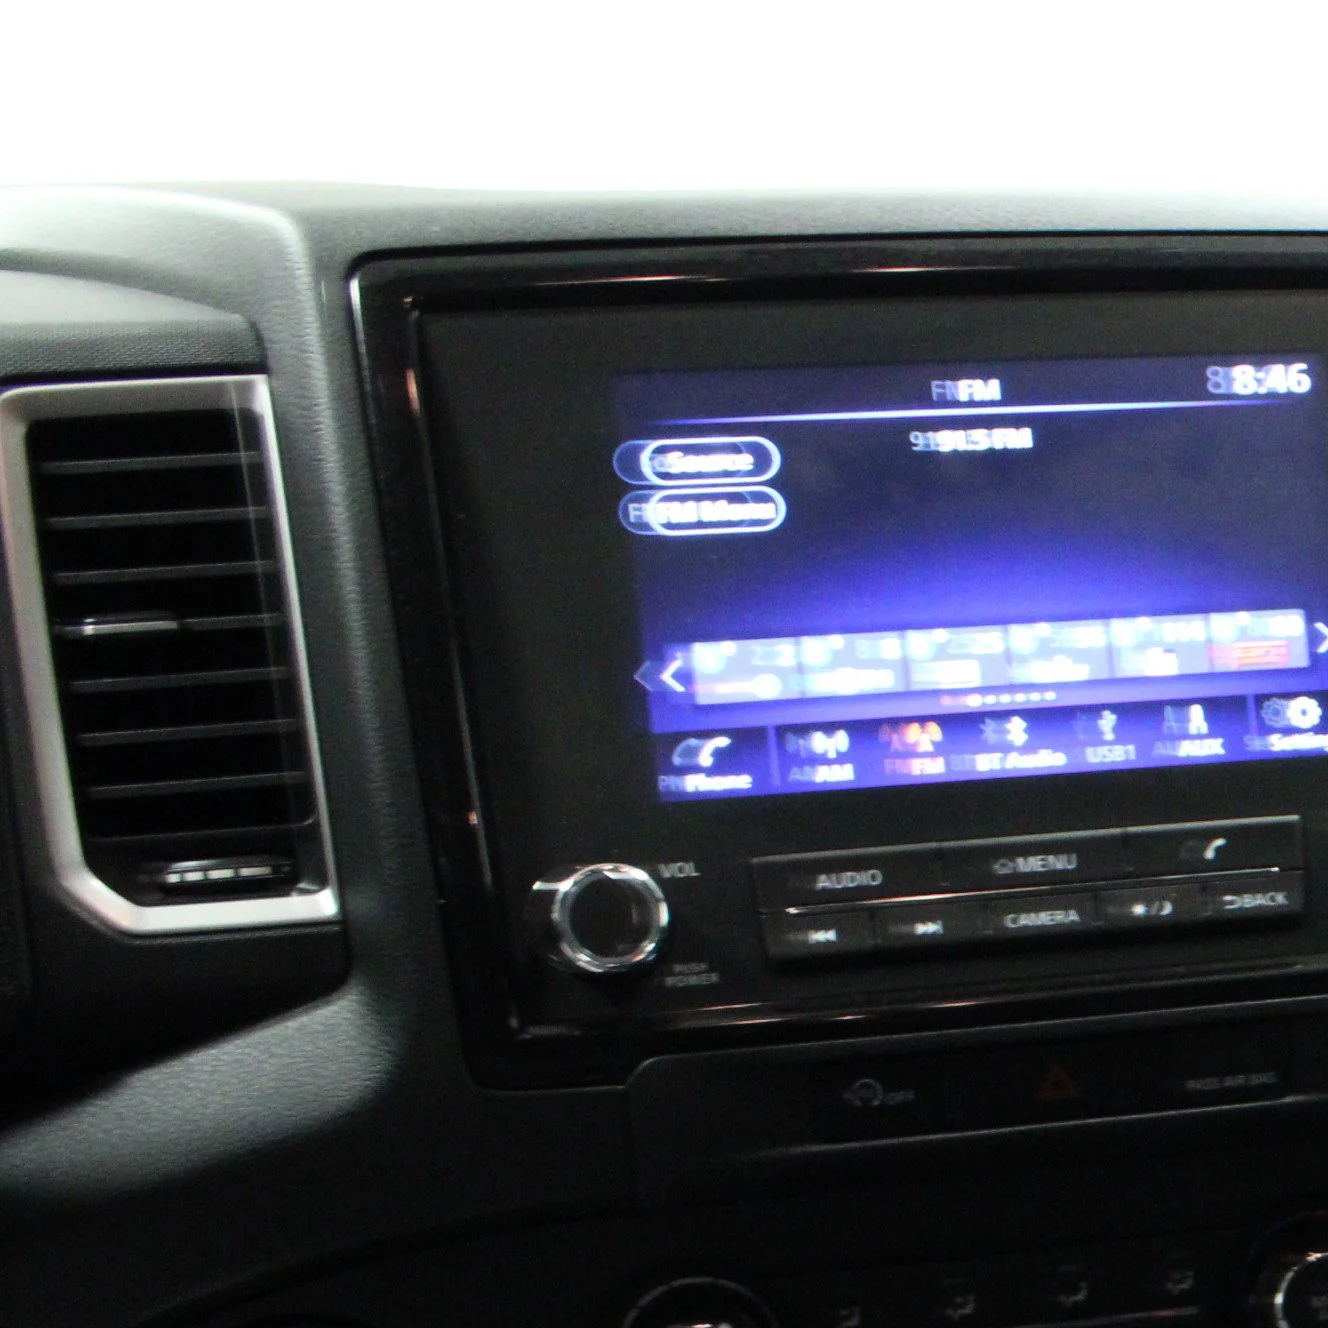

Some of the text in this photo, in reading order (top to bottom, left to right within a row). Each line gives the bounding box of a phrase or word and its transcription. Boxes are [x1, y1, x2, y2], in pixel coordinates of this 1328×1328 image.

[1231, 362, 1312, 395] 8:46
[957, 379, 1001, 401] FM
[814, 763, 854, 783] AM
[908, 757, 945, 775] FM
[658, 861, 701, 879] VOL
[1015, 853, 1078, 873] MENU
[815, 869, 883, 890] AUDIO
[1241, 891, 1289, 908] BACK
[1003, 908, 1081, 929] CAMERA
